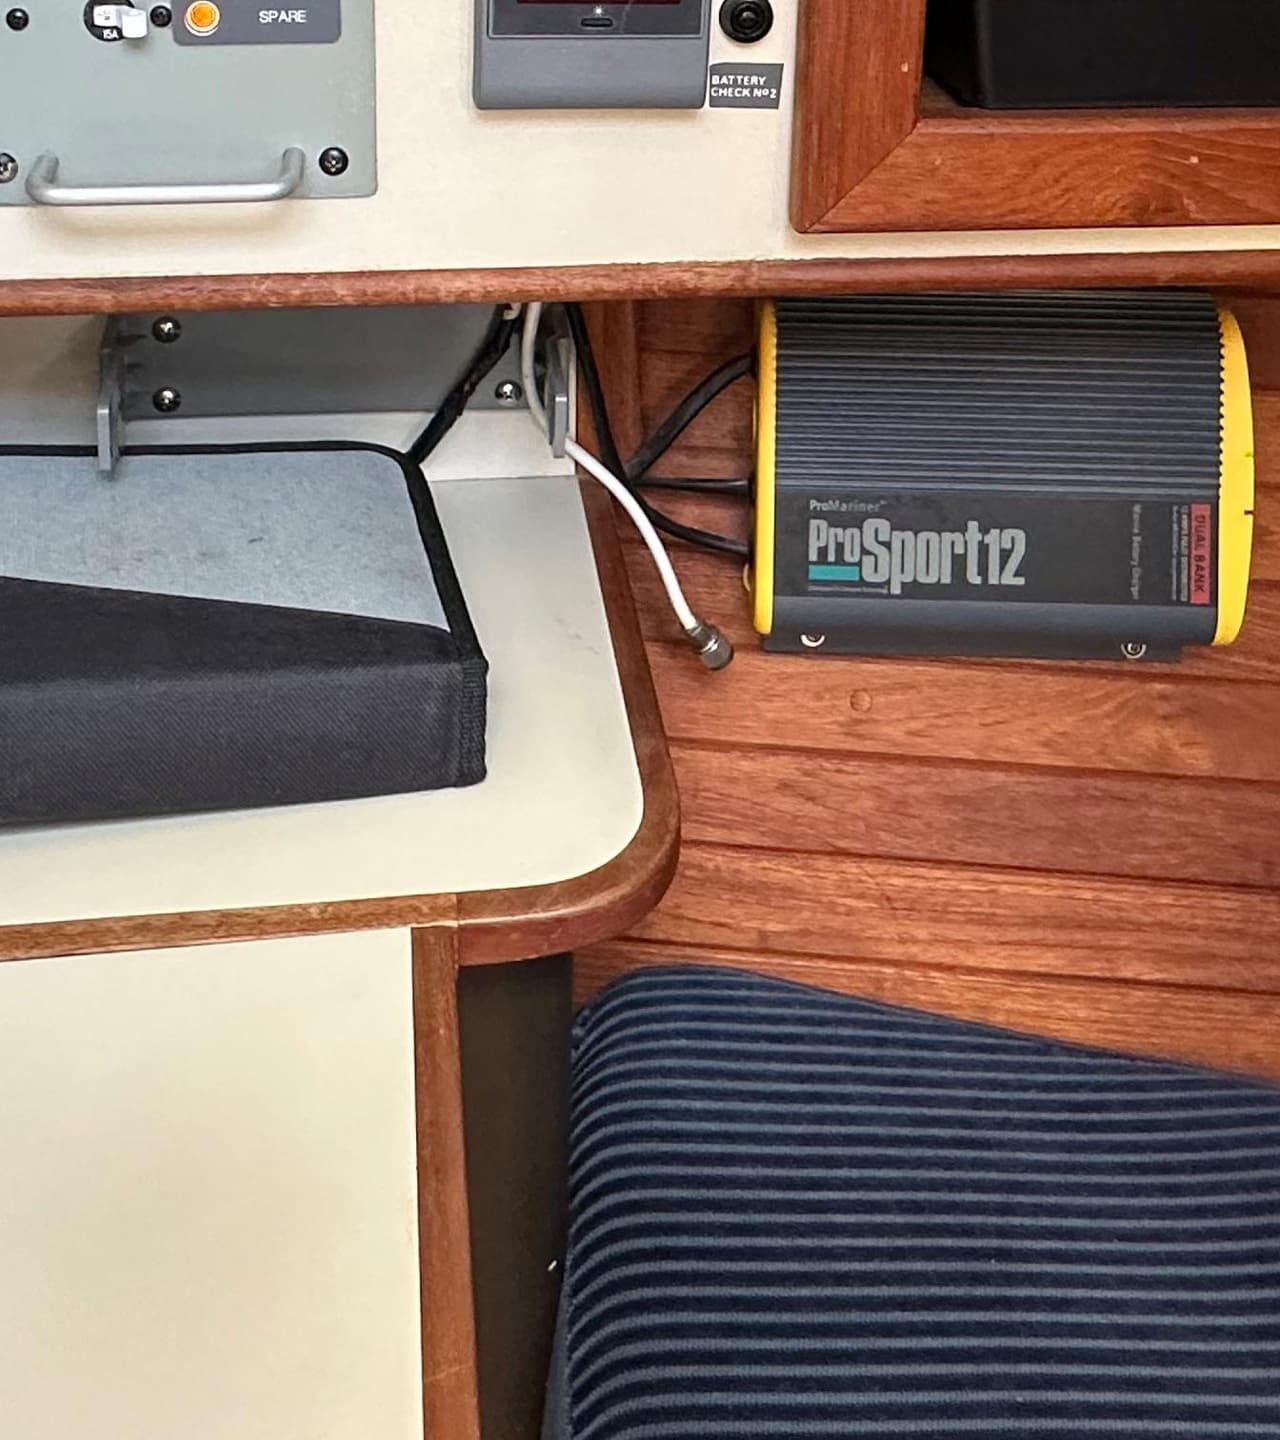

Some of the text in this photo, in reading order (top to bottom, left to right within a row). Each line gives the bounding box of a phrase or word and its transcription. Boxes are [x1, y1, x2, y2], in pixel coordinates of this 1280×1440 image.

[258, 10, 308, 24] SPARE
[102, 28, 119, 40] 15A
[711, 74, 767, 86] BATTERY
[711, 86, 751, 97] CHECK
[808, 517, 1027, 595] ProSport12
[1194, 513, 1206, 594] DUAL BANK
